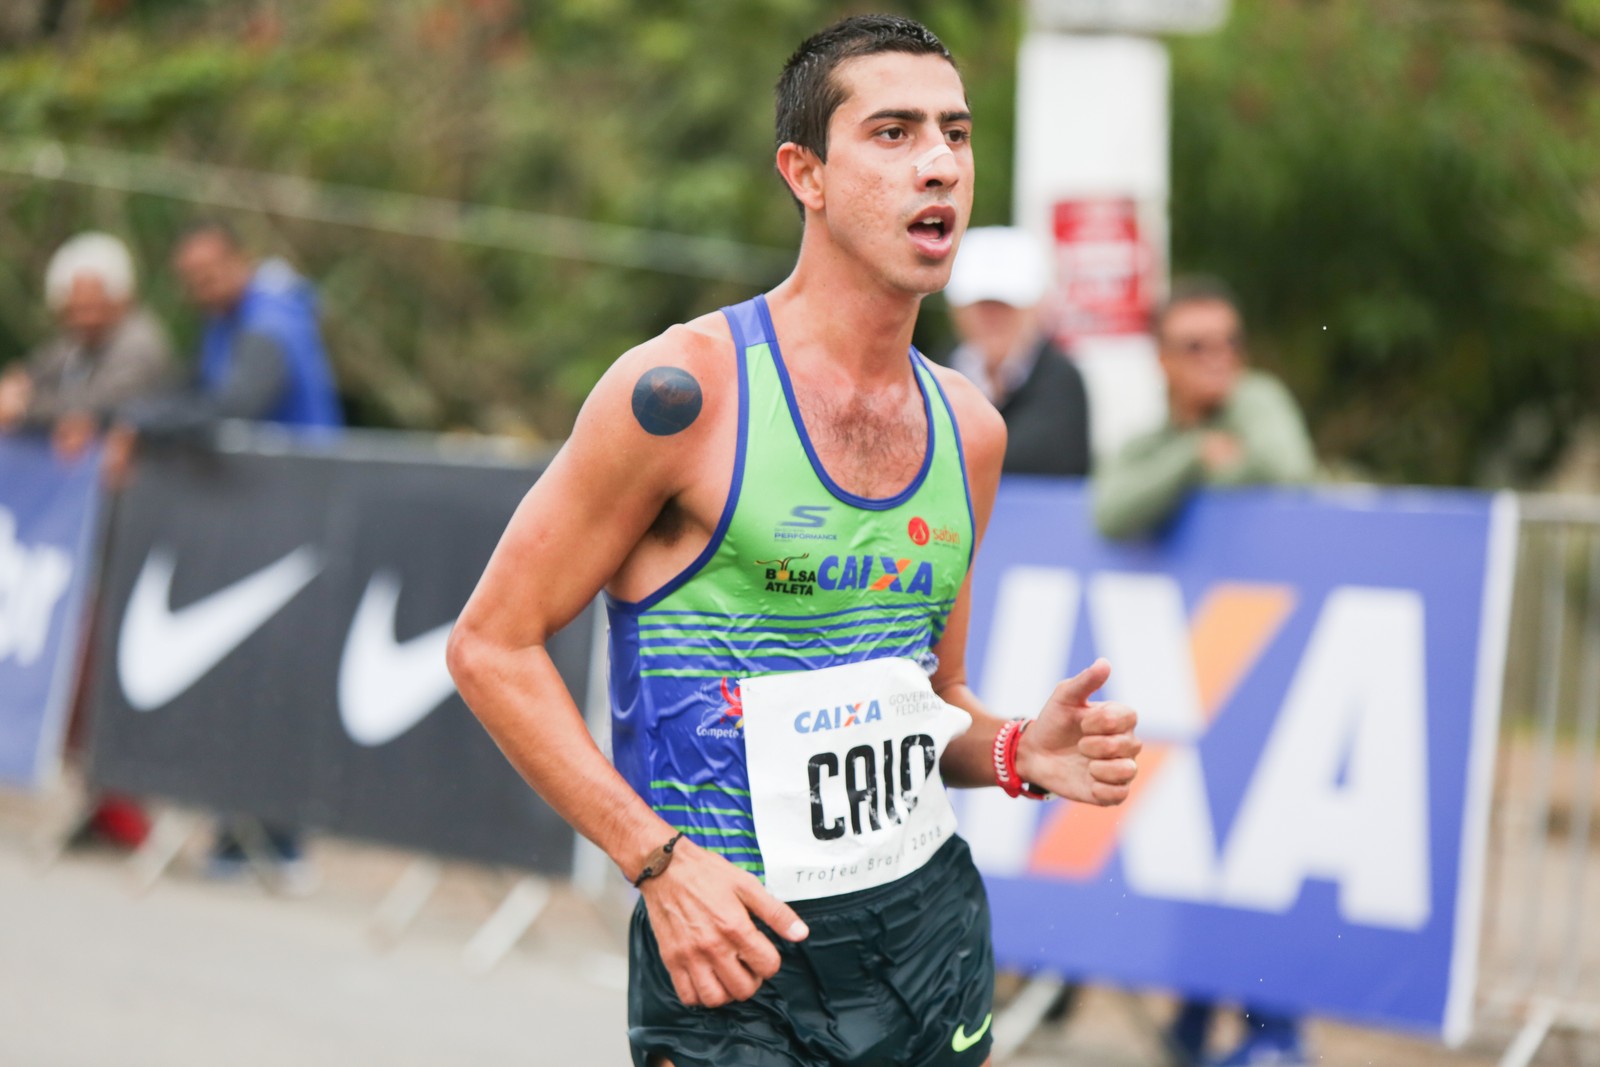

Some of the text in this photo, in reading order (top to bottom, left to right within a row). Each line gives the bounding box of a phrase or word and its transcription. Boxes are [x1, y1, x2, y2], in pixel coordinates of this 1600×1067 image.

[774, 532, 837, 541] PERFORMANCE
[765, 567, 817, 583] BOLSA
[817, 555, 933, 596] CAIXA
[765, 581, 813, 596] ATLETA
[793, 700, 882, 733] CAIXA
[696, 724, 740, 739] Compete
[957, 566, 1432, 931] IXA
[807, 733, 935, 841] CAIO
